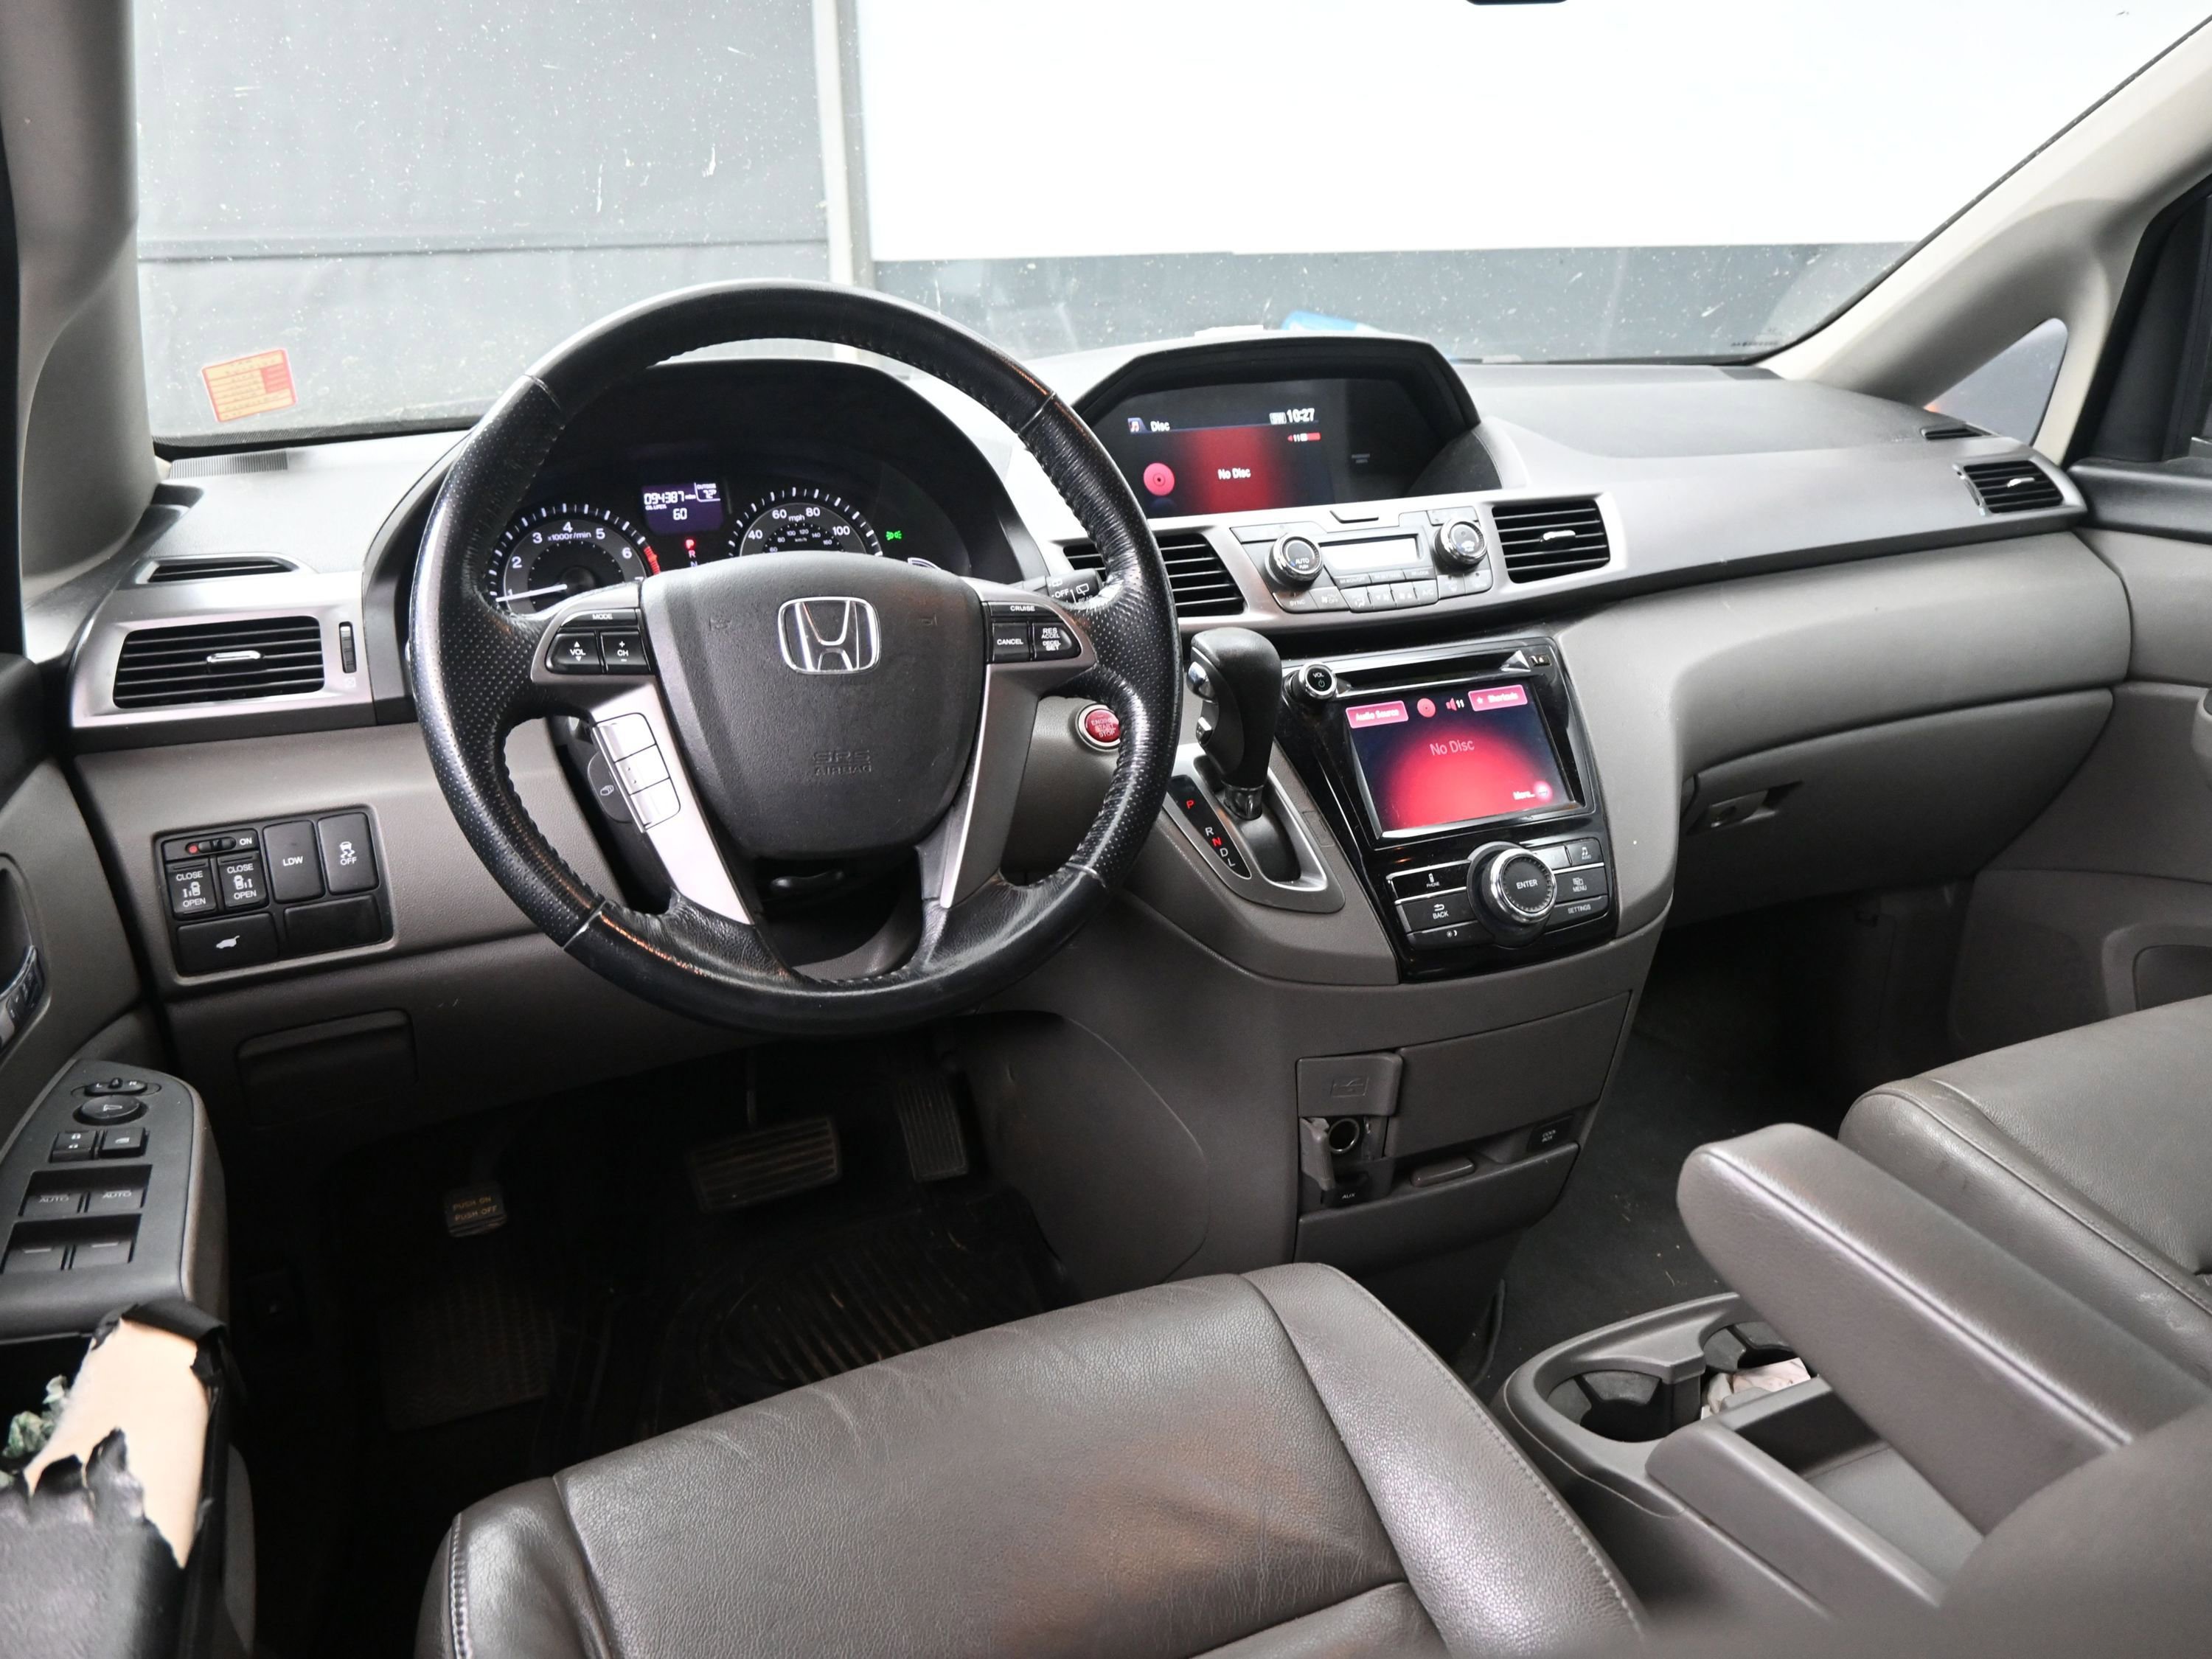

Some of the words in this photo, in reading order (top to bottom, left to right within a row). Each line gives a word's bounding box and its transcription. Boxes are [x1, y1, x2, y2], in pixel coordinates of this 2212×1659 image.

[1287, 408, 1315, 422] 10:27
[1150, 420, 1170, 432] Disc
[1217, 468, 1231, 480] No
[1232, 467, 1251, 479] Disc
[644, 490, 684, 505] 094387
[672, 507, 687, 521] 60
[772, 509, 787, 519] 60
[806, 507, 821, 517] 80
[788, 514, 805, 523] mph
[563, 521, 573, 533] 4
[832, 525, 850, 536] 100
[532, 532, 543, 544] 3
[596, 528, 605, 540] 5
[748, 529, 763, 540] 40
[686, 539, 695, 549] P
[622, 547, 632, 559] 6
[688, 549, 696, 558] R
[512, 556, 522, 568] 2
[1054, 588, 1069, 598] OFF
[1430, 742, 1447, 756] No
[1449, 739, 1475, 754] Disc
[1186, 799, 1194, 809] P
[1205, 827, 1214, 836] R
[240, 838, 252, 846] ON
[1211, 837, 1222, 847] N
[1220, 848, 1228, 858] D
[282, 856, 303, 867] LDW
[340, 857, 357, 866] OFF
[1228, 858, 1236, 867] L
[226, 863, 254, 874] CLOSE
[175, 870, 204, 883] CLOSE
[1516, 879, 1538, 890] ENTER
[1572, 885, 1587, 893] MENU
[233, 890, 257, 900] OPEN
[182, 897, 206, 908] OPEN
[1568, 904, 1591, 914] SETTINGS
[1433, 911, 1449, 919] BACK
